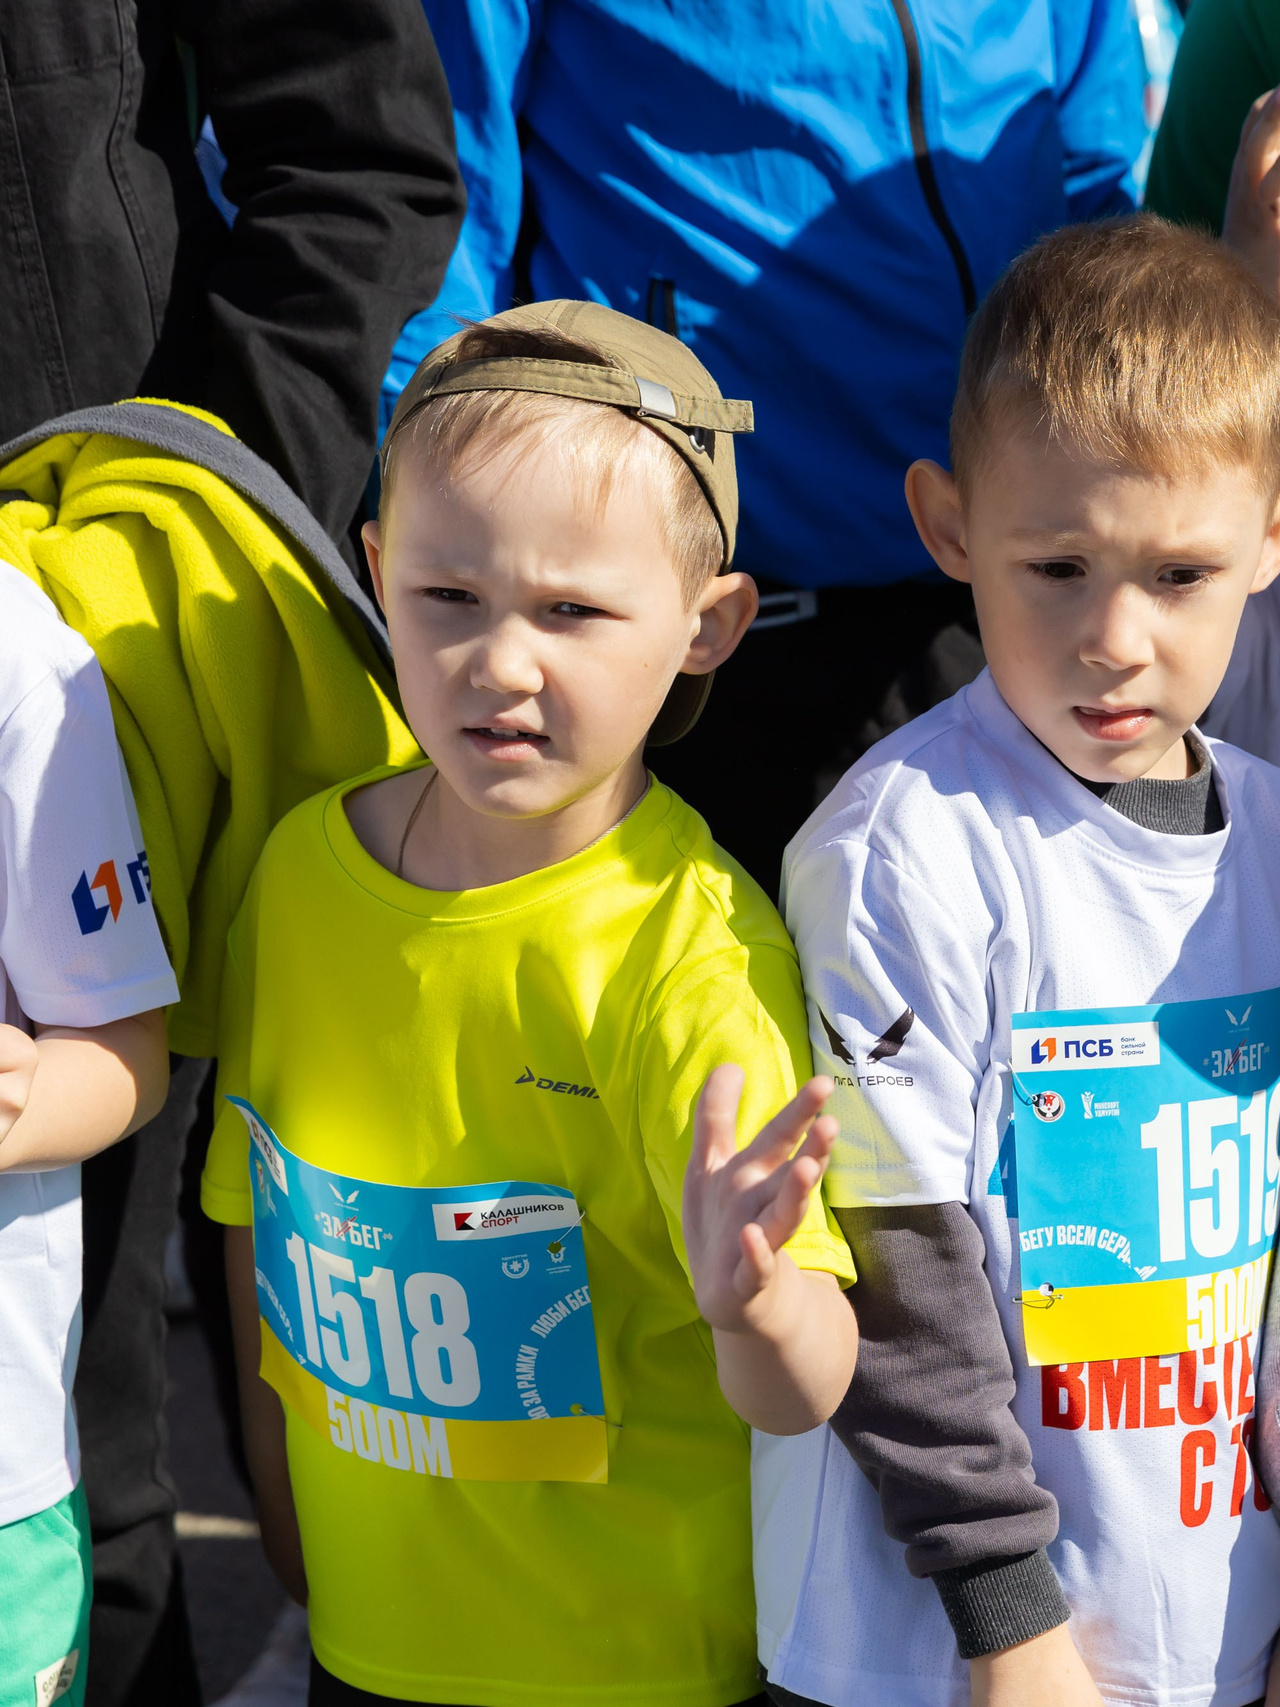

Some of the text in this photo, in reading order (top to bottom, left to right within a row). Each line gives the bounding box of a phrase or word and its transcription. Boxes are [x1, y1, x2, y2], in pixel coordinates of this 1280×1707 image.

[1064, 1039, 1114, 1058] ПСБ
[1120, 1042, 1146, 1050] сильной
[857, 1075, 914, 1087] ГЕРОЕВ
[481, 1204, 565, 1220] КАЛАШНИКОВ
[481, 1216, 519, 1229] СПОРТ
[1019, 1226, 1053, 1252] БЕГУ
[1057, 1225, 1097, 1246] ВСЕМ
[285, 1231, 481, 1408] 1518
[530, 1285, 592, 1339] ЛЮБИ БЕГ
[515, 1344, 539, 1389] РАМКИ
[520, 1389, 542, 1407] ЗА
[325, 1383, 454, 1479] 500М
[1180, 1429, 1217, 1528] С
